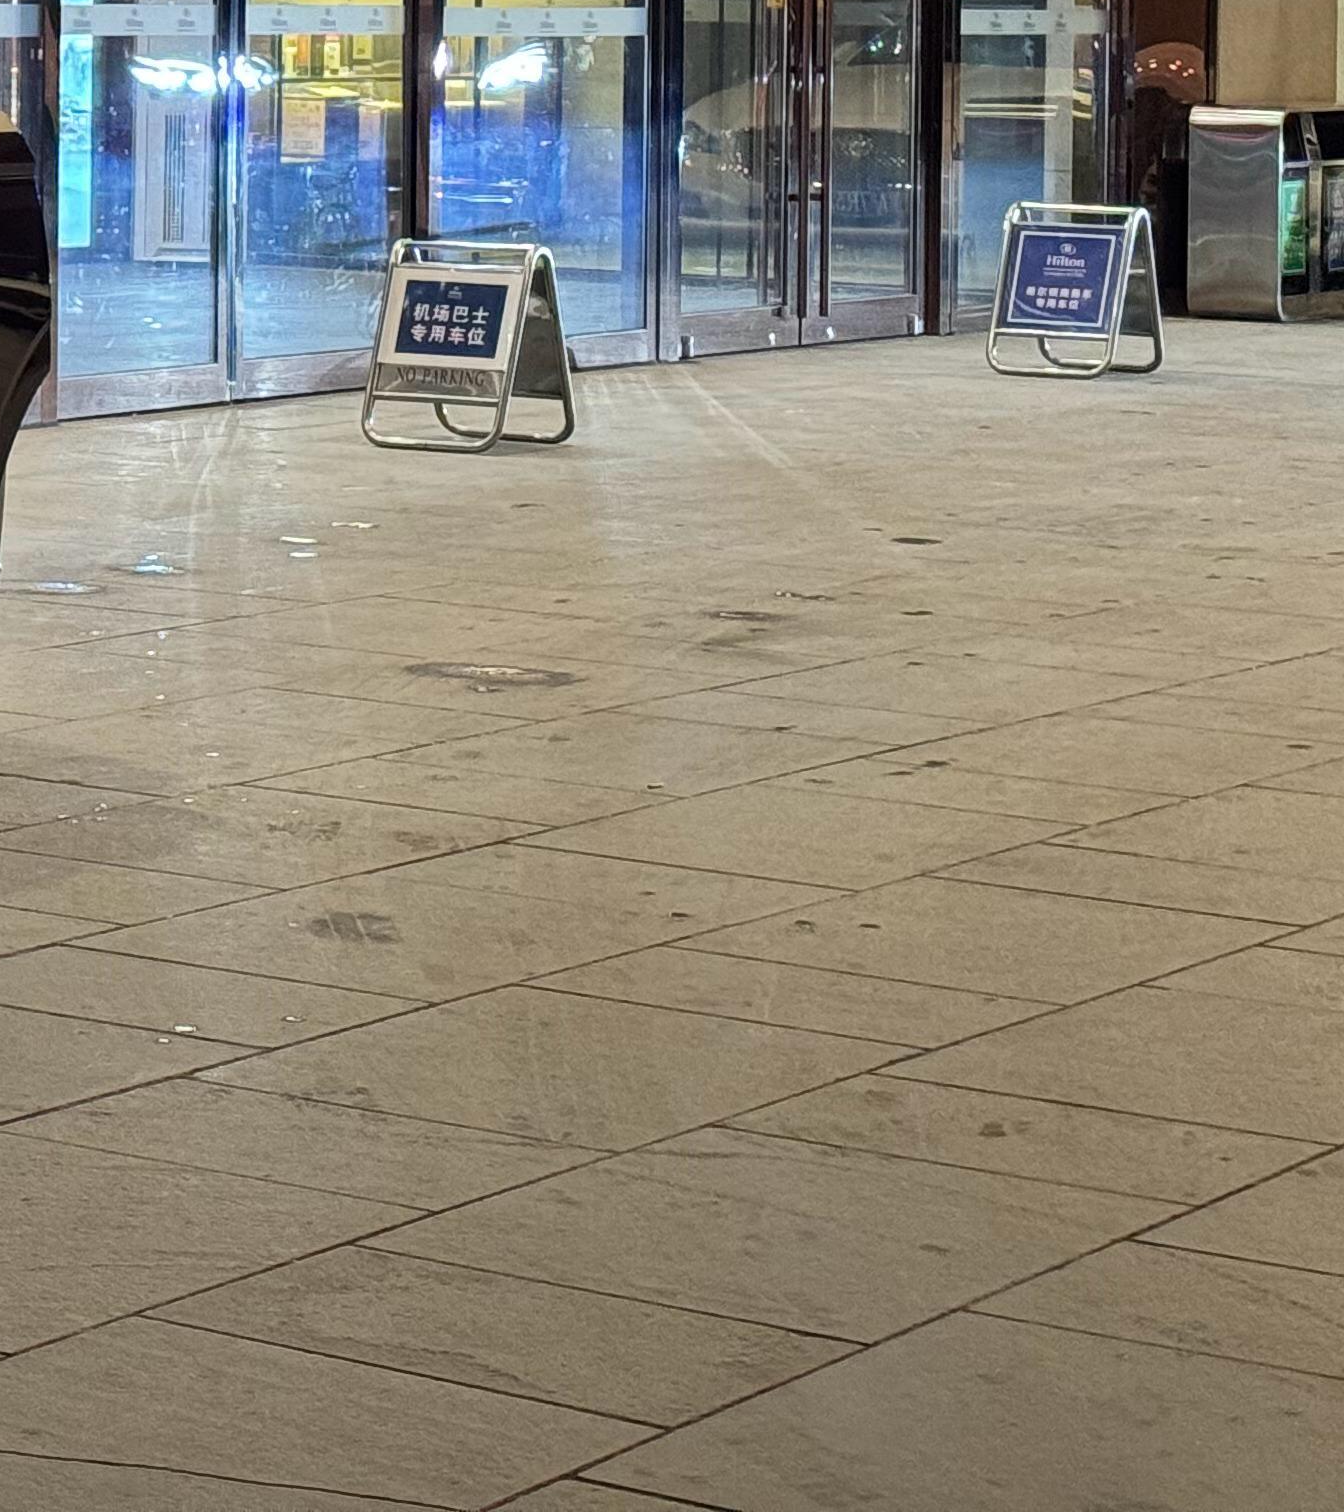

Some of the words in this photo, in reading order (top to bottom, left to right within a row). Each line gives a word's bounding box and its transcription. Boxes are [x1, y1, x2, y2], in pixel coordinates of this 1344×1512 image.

[1046, 253, 1086, 268] Hilton
[413, 302, 490, 325] 机场巴士
[1035, 297, 1080, 310] 专用车位
[410, 323, 487, 345] 专用车位
[396, 366, 416, 383] NO
[422, 368, 485, 387] PARKING
